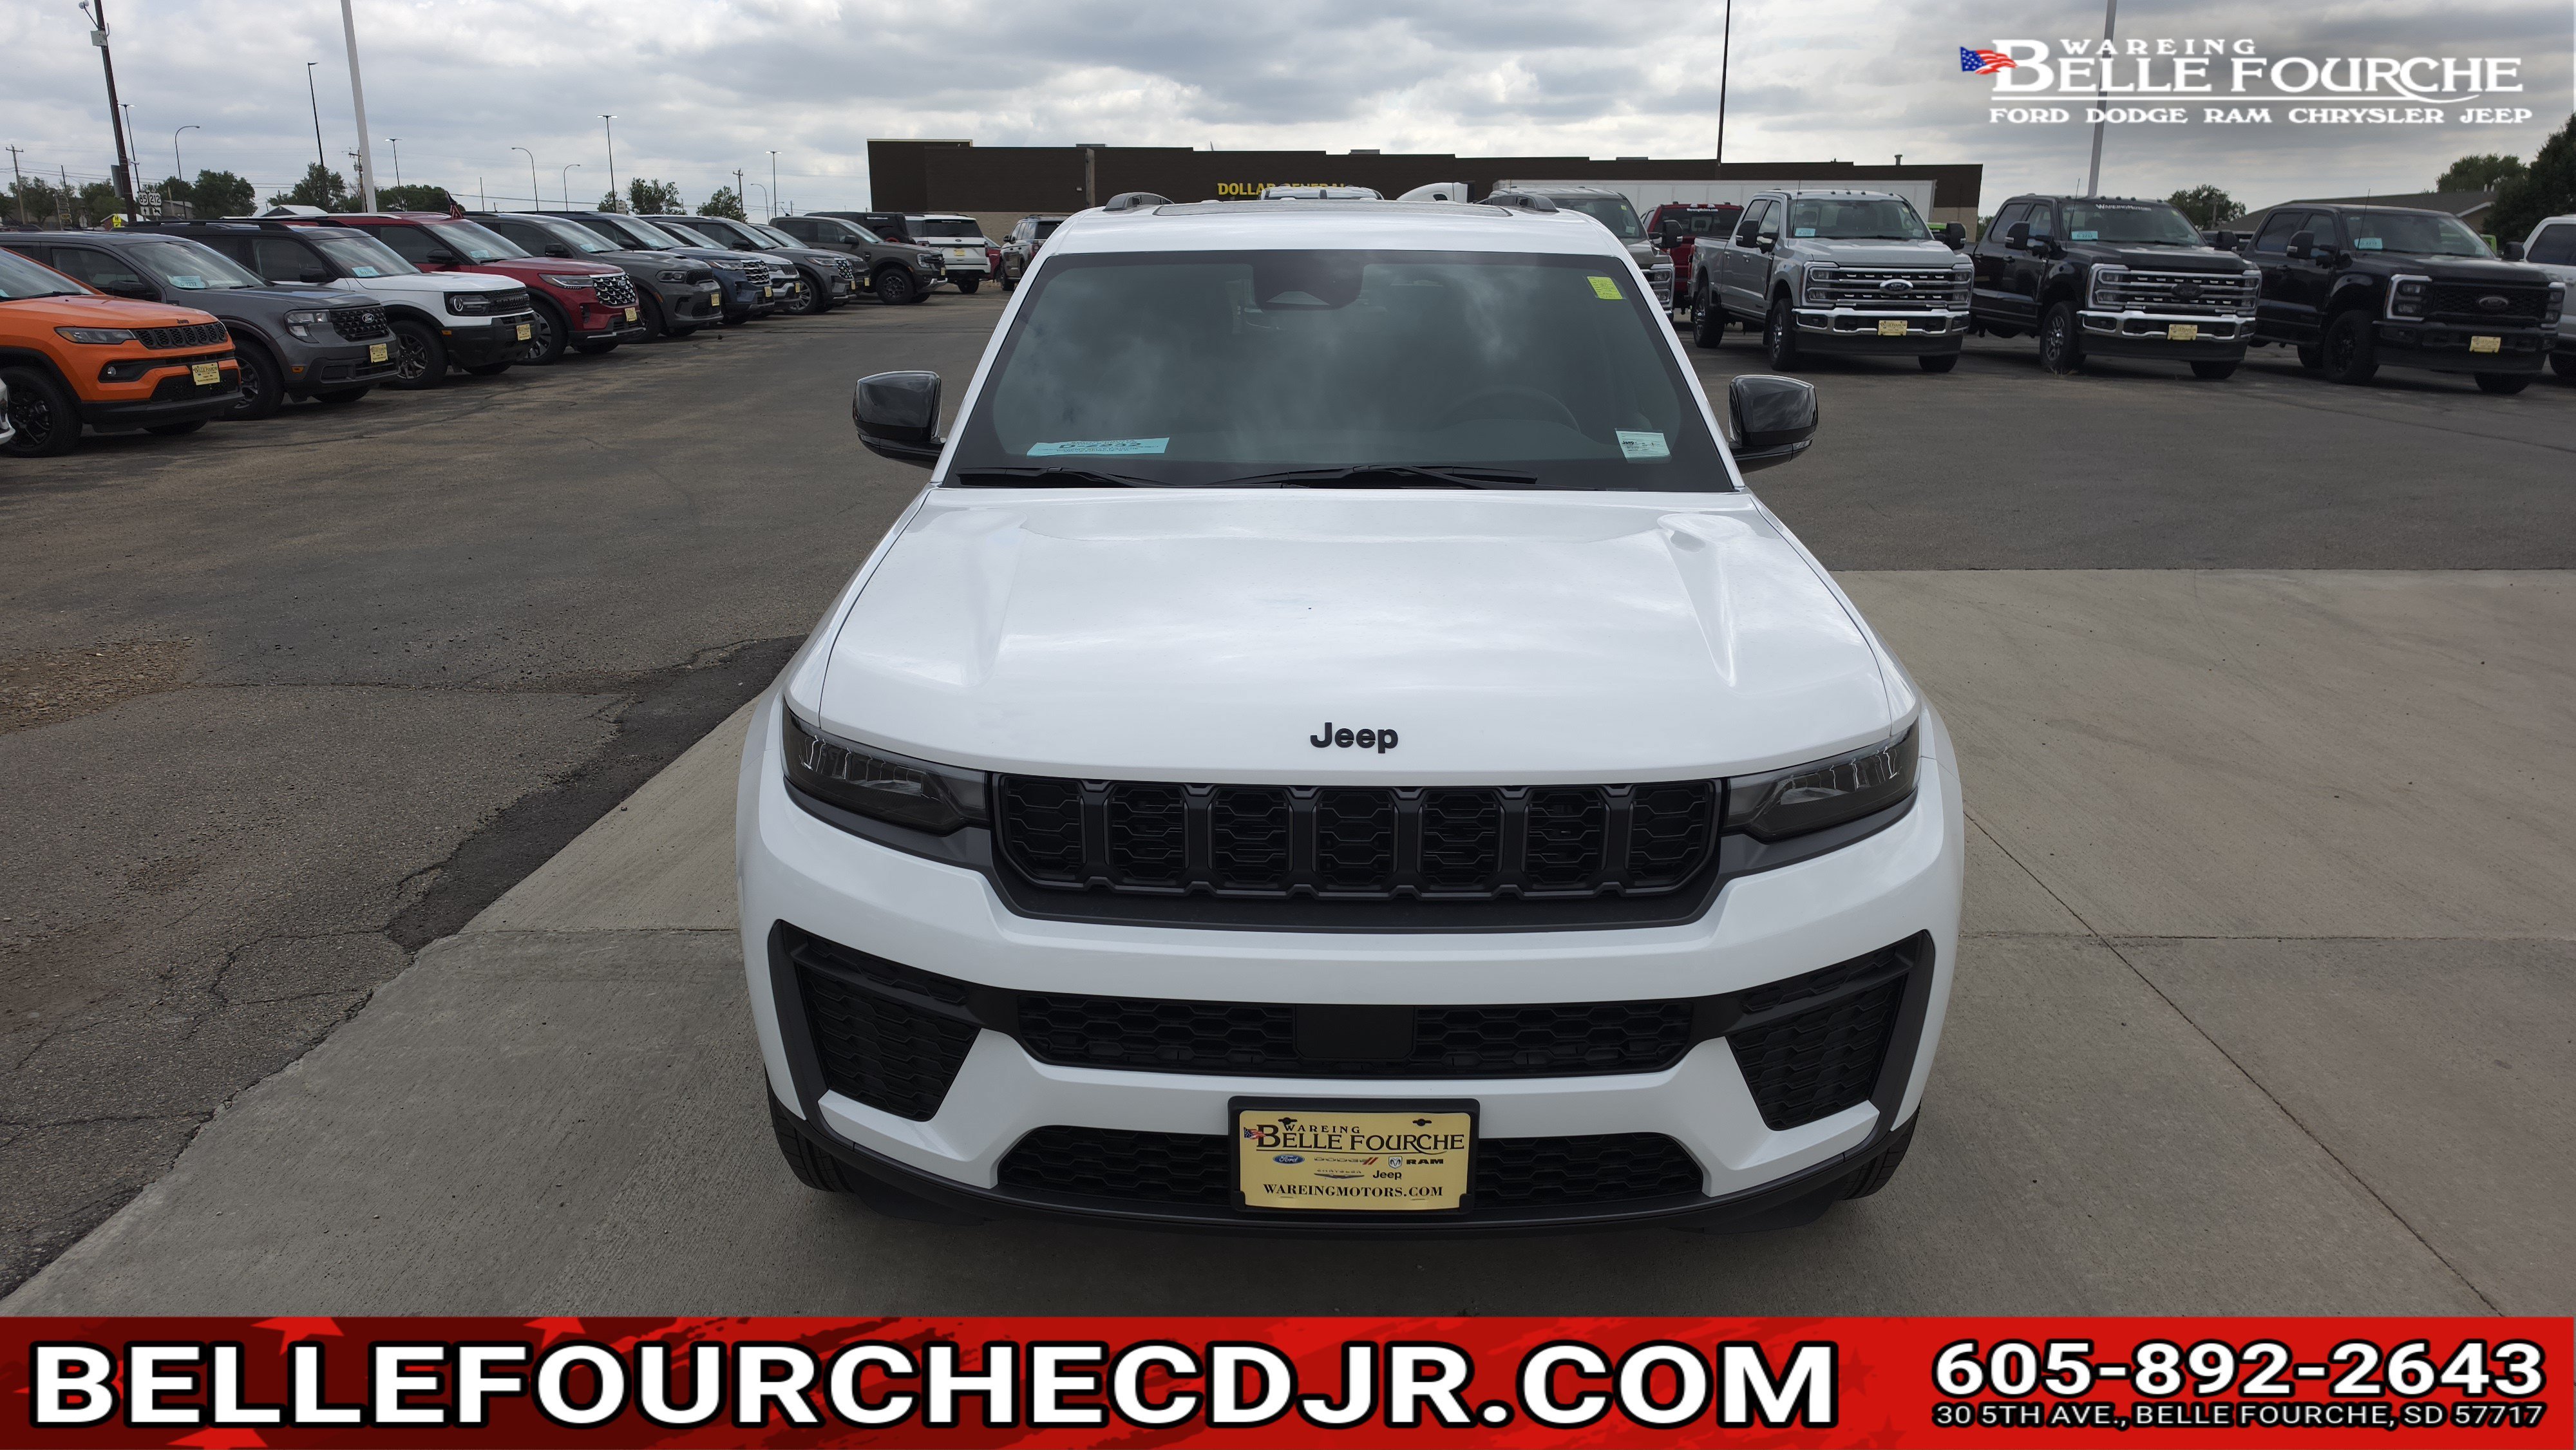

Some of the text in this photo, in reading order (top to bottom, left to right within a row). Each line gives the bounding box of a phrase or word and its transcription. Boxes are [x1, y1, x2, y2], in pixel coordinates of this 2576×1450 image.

[149, 194, 161, 203] 212
[1310, 722, 1399, 754] Jeep
[1284, 1124, 1360, 1134] WAREING
[1256, 1124, 1464, 1153] BELLE FOURCHE
[1372, 1170, 1402, 1180] Jeep
[1263, 1183, 1443, 1198] WAREINGMOTORS.COM
